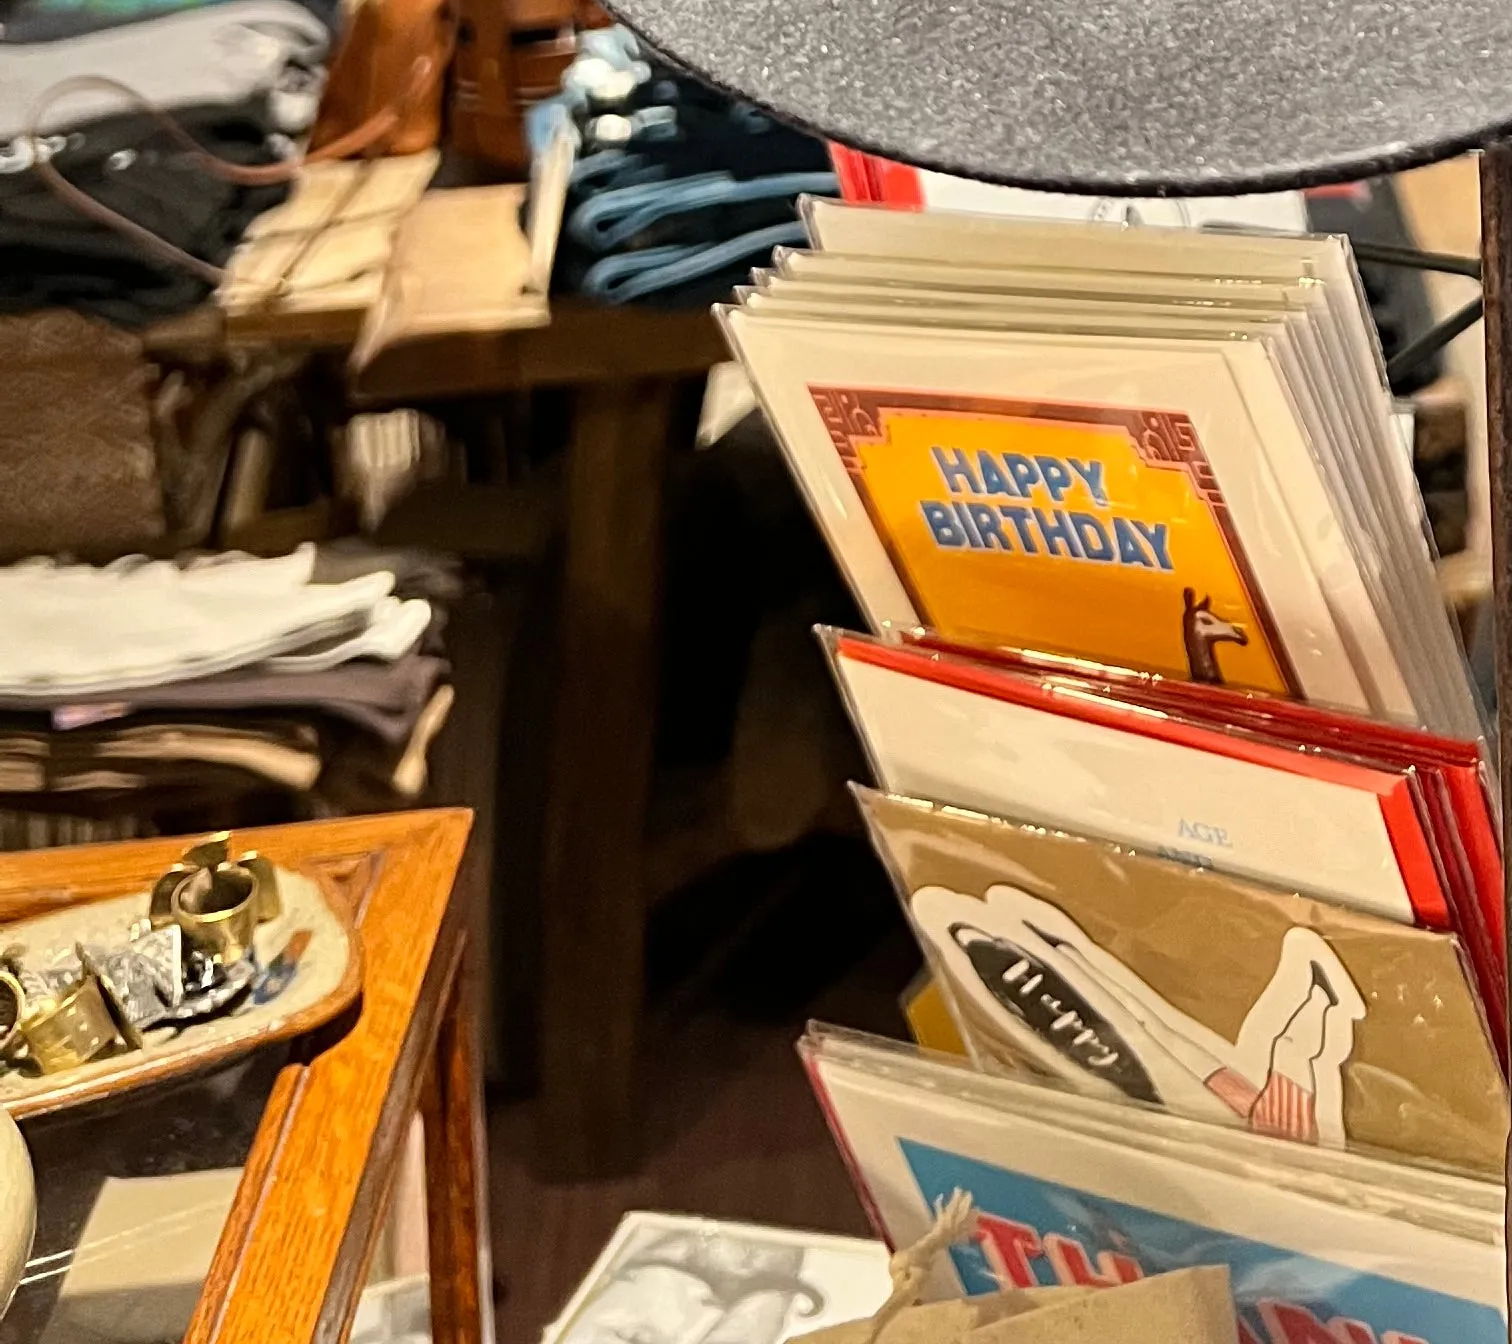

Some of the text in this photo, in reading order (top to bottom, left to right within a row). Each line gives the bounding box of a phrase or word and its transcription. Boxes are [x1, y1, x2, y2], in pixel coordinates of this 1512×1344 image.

[930, 445, 1109, 506] HAPPY
[920, 500, 1174, 571] BIRTHDAY
[1002, 960, 1119, 1066] Happy
